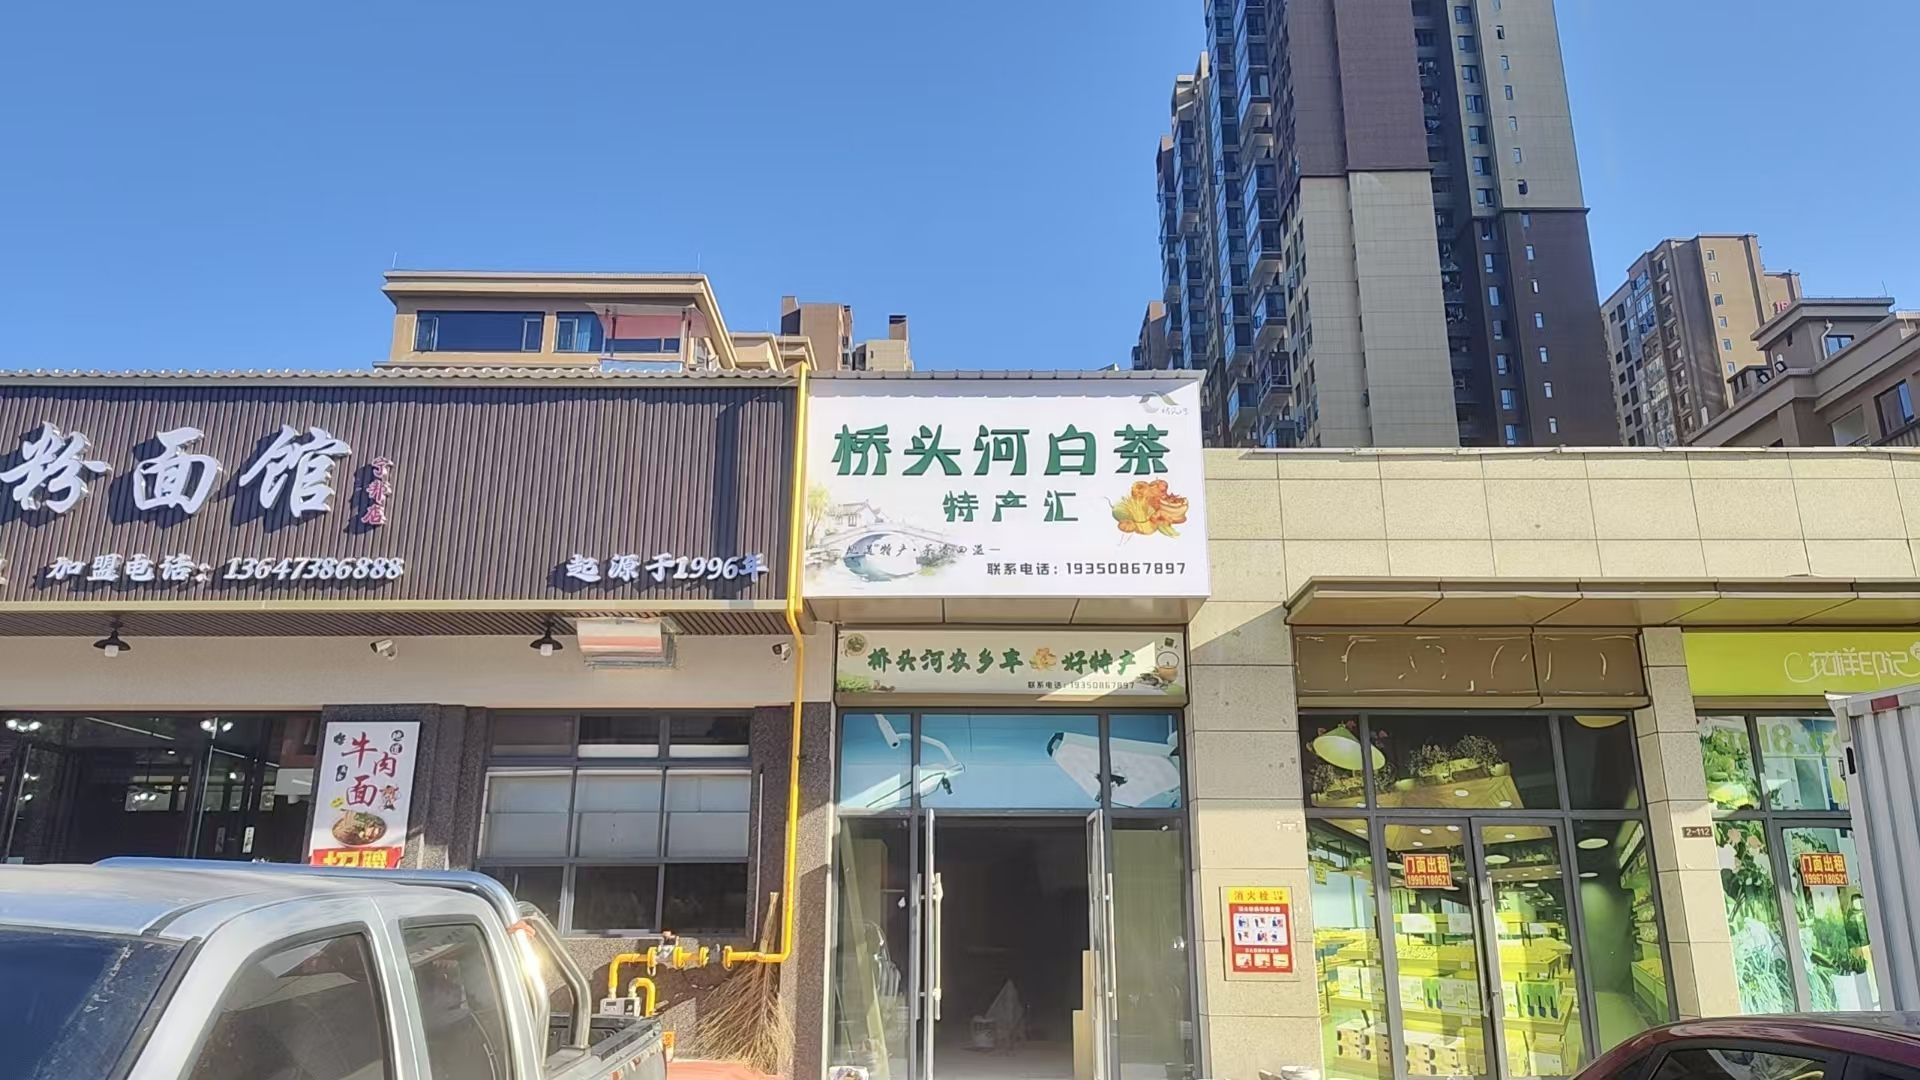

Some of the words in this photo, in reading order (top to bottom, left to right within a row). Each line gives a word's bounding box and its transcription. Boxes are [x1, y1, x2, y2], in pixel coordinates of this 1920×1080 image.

[831, 423, 1170, 476] 桥头河白茶
[0, 420, 352, 517] 粉面馆
[942, 489, 1079, 522] 特产汇
[566, 552, 770, 583] 起源于1996年
[987, 562, 1186, 575] 联系电话：19350867897
[1686, 828, 1710, 836] 2-112
[1405, 855, 1449, 873] 门面出租
[1802, 854, 1846, 873] 门面出租
